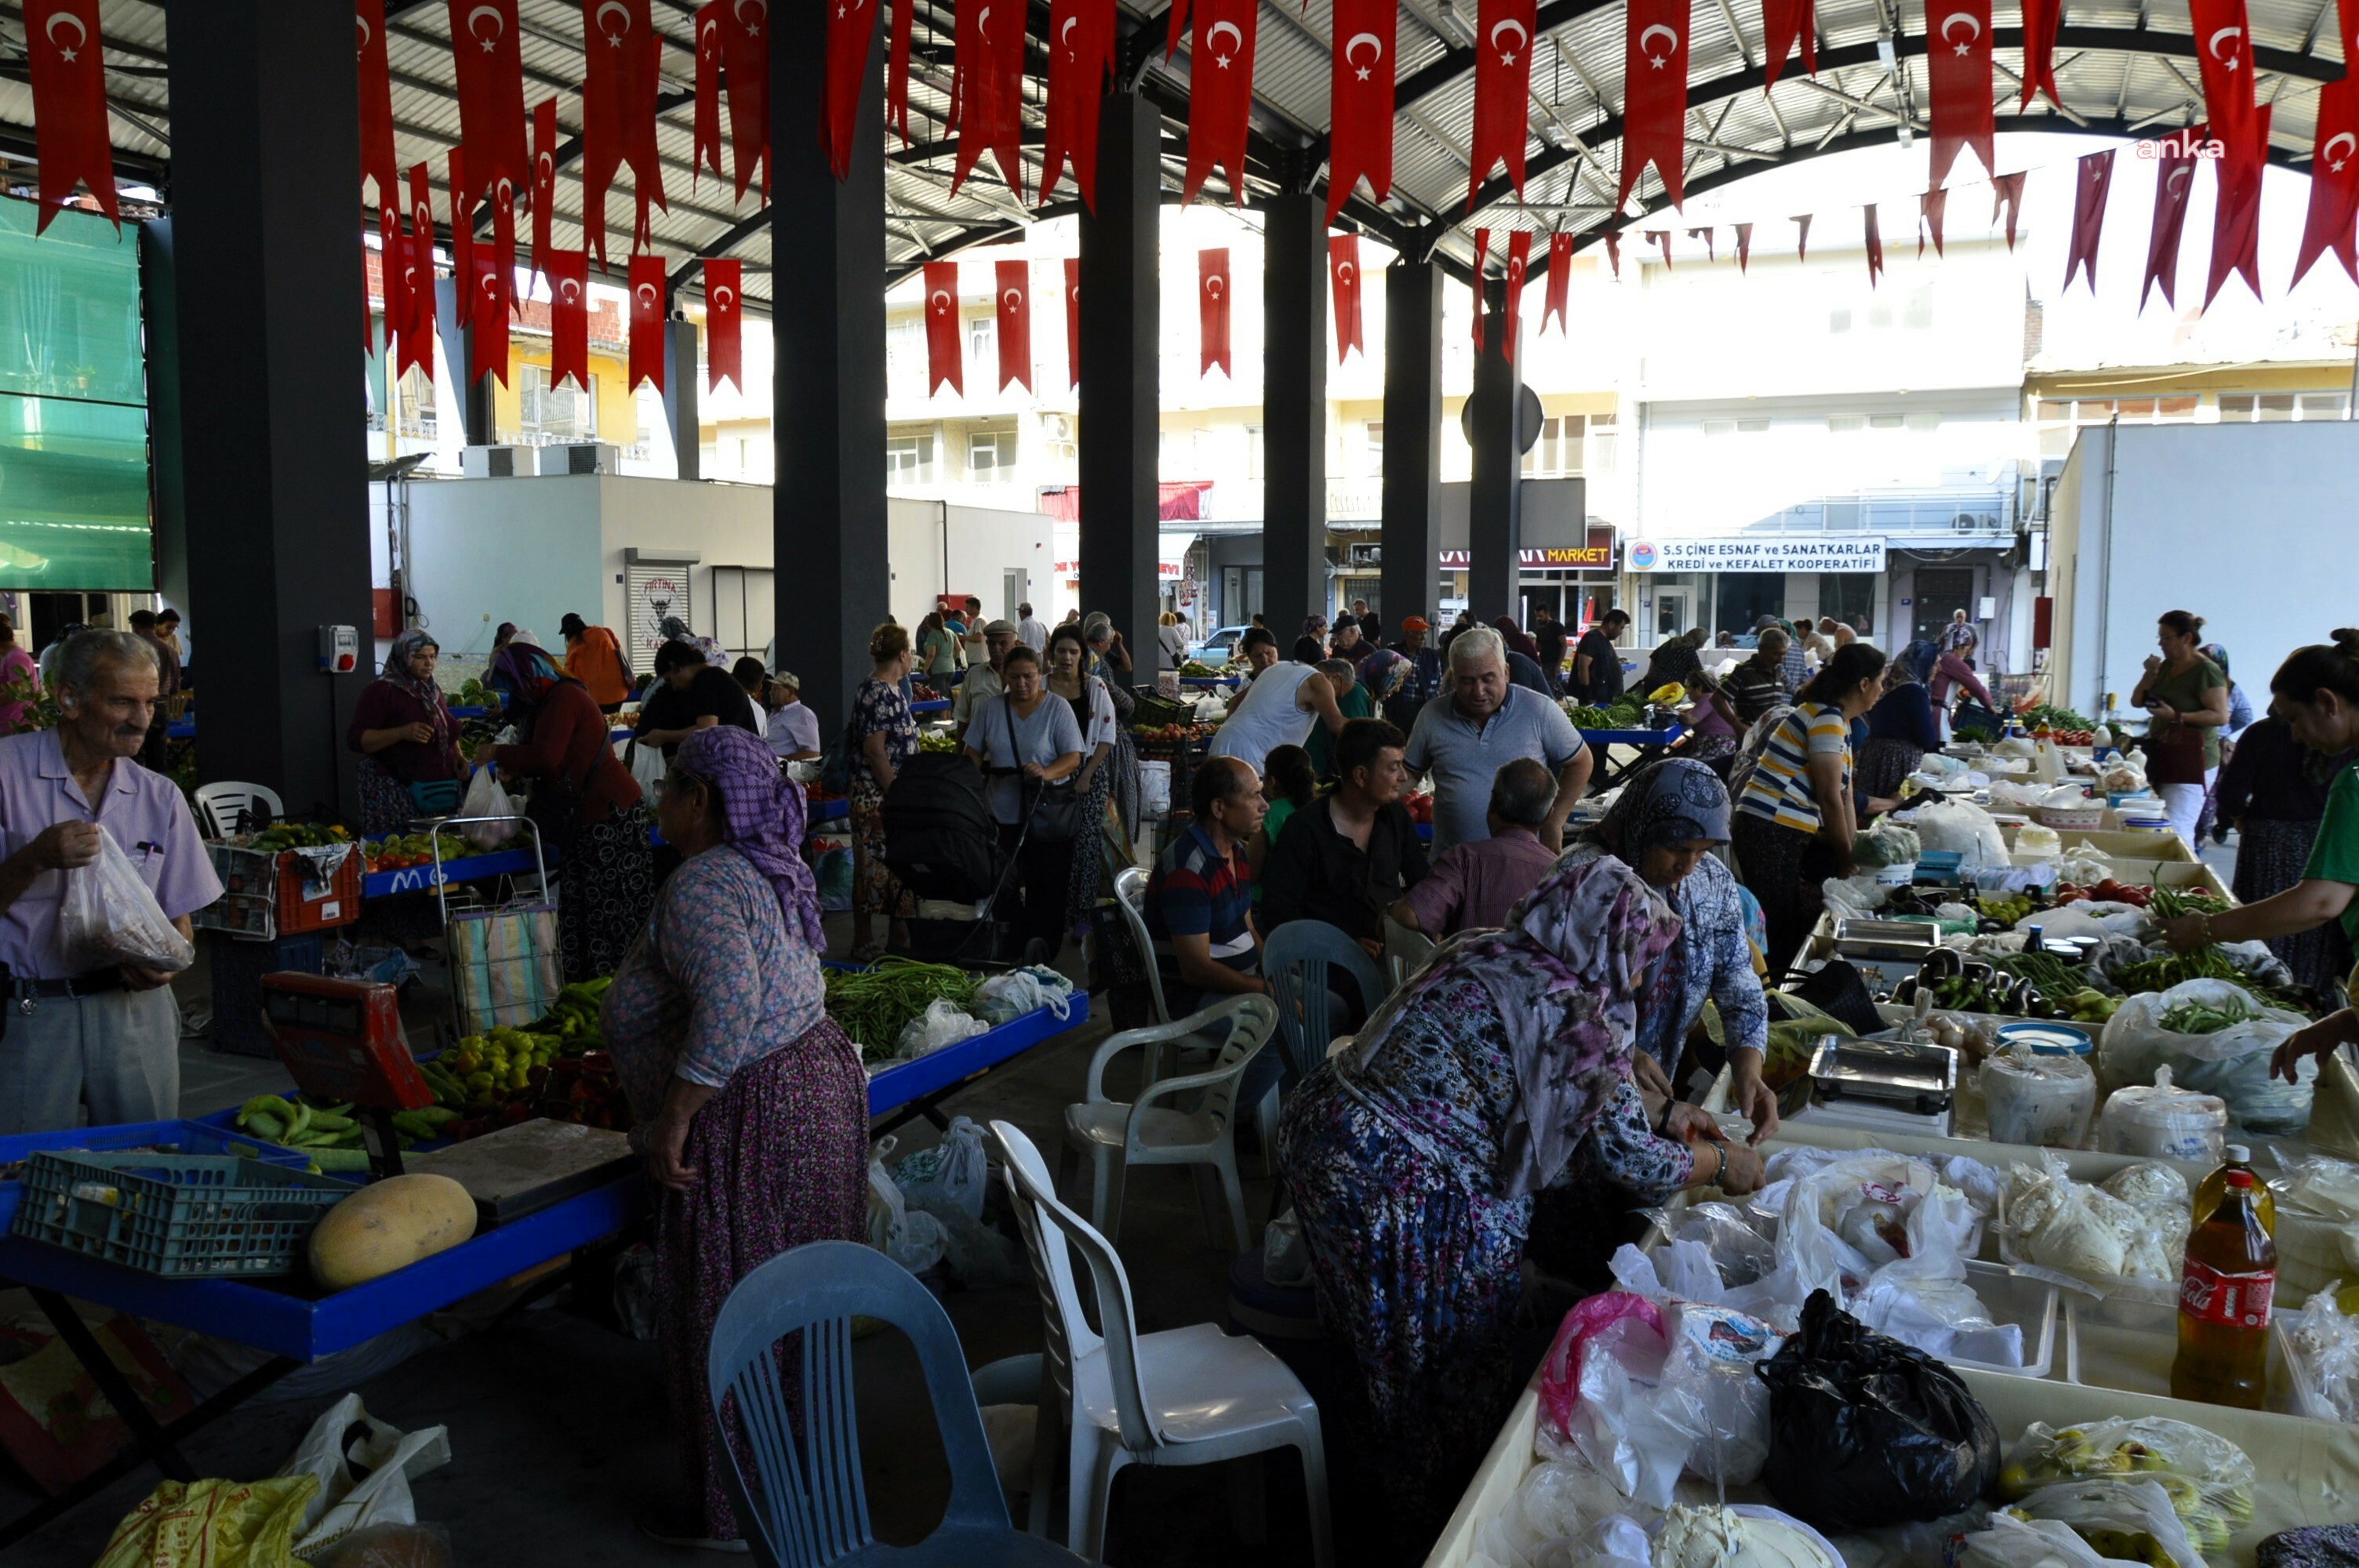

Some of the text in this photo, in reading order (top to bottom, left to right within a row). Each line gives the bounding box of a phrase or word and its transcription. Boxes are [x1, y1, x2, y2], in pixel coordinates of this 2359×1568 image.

[1547, 548, 1608, 562] MARKET
[1663, 542, 1881, 556] S.S ÇİNE ESNAF ve SANATKARLAR
[1667, 556, 1876, 569] KREDİ ve KEFALET KOOPERATİFİ
